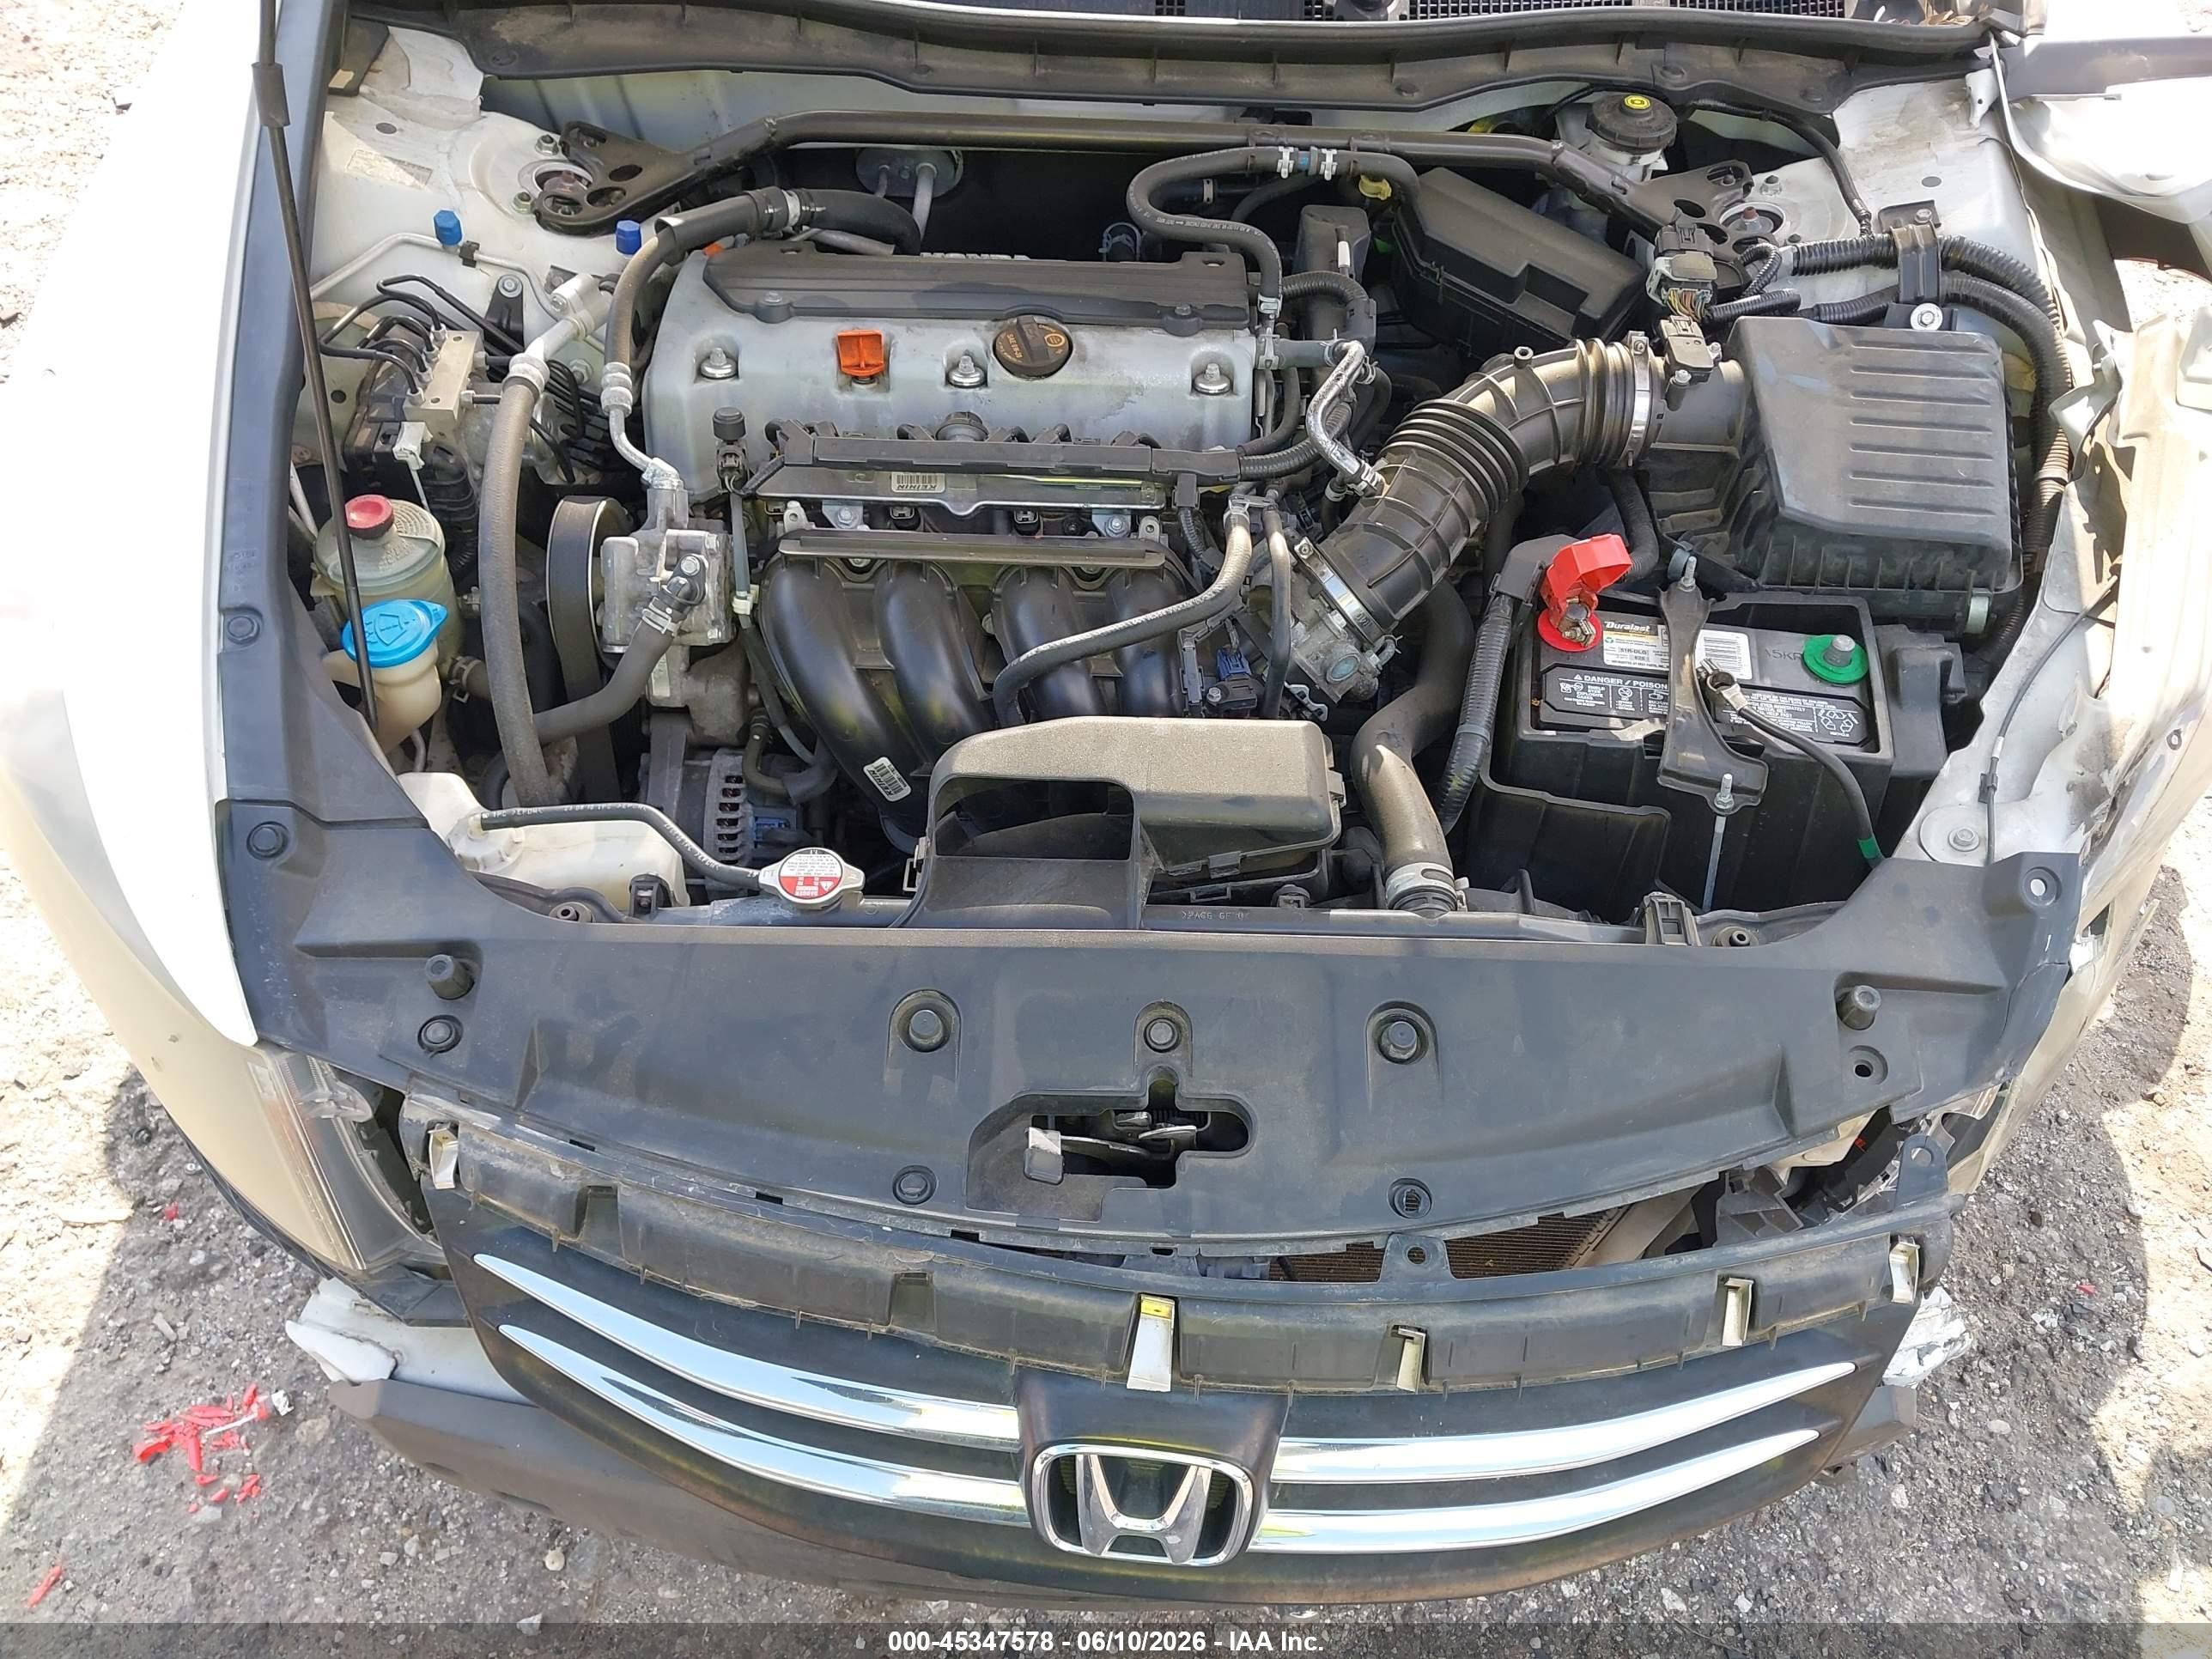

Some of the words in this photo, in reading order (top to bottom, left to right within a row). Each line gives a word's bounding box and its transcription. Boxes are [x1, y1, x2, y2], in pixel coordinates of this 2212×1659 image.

[1605, 621, 1650, 632] Duralast
[1584, 675, 1623, 685] DANGER
[1632, 681, 1668, 690] POISON
